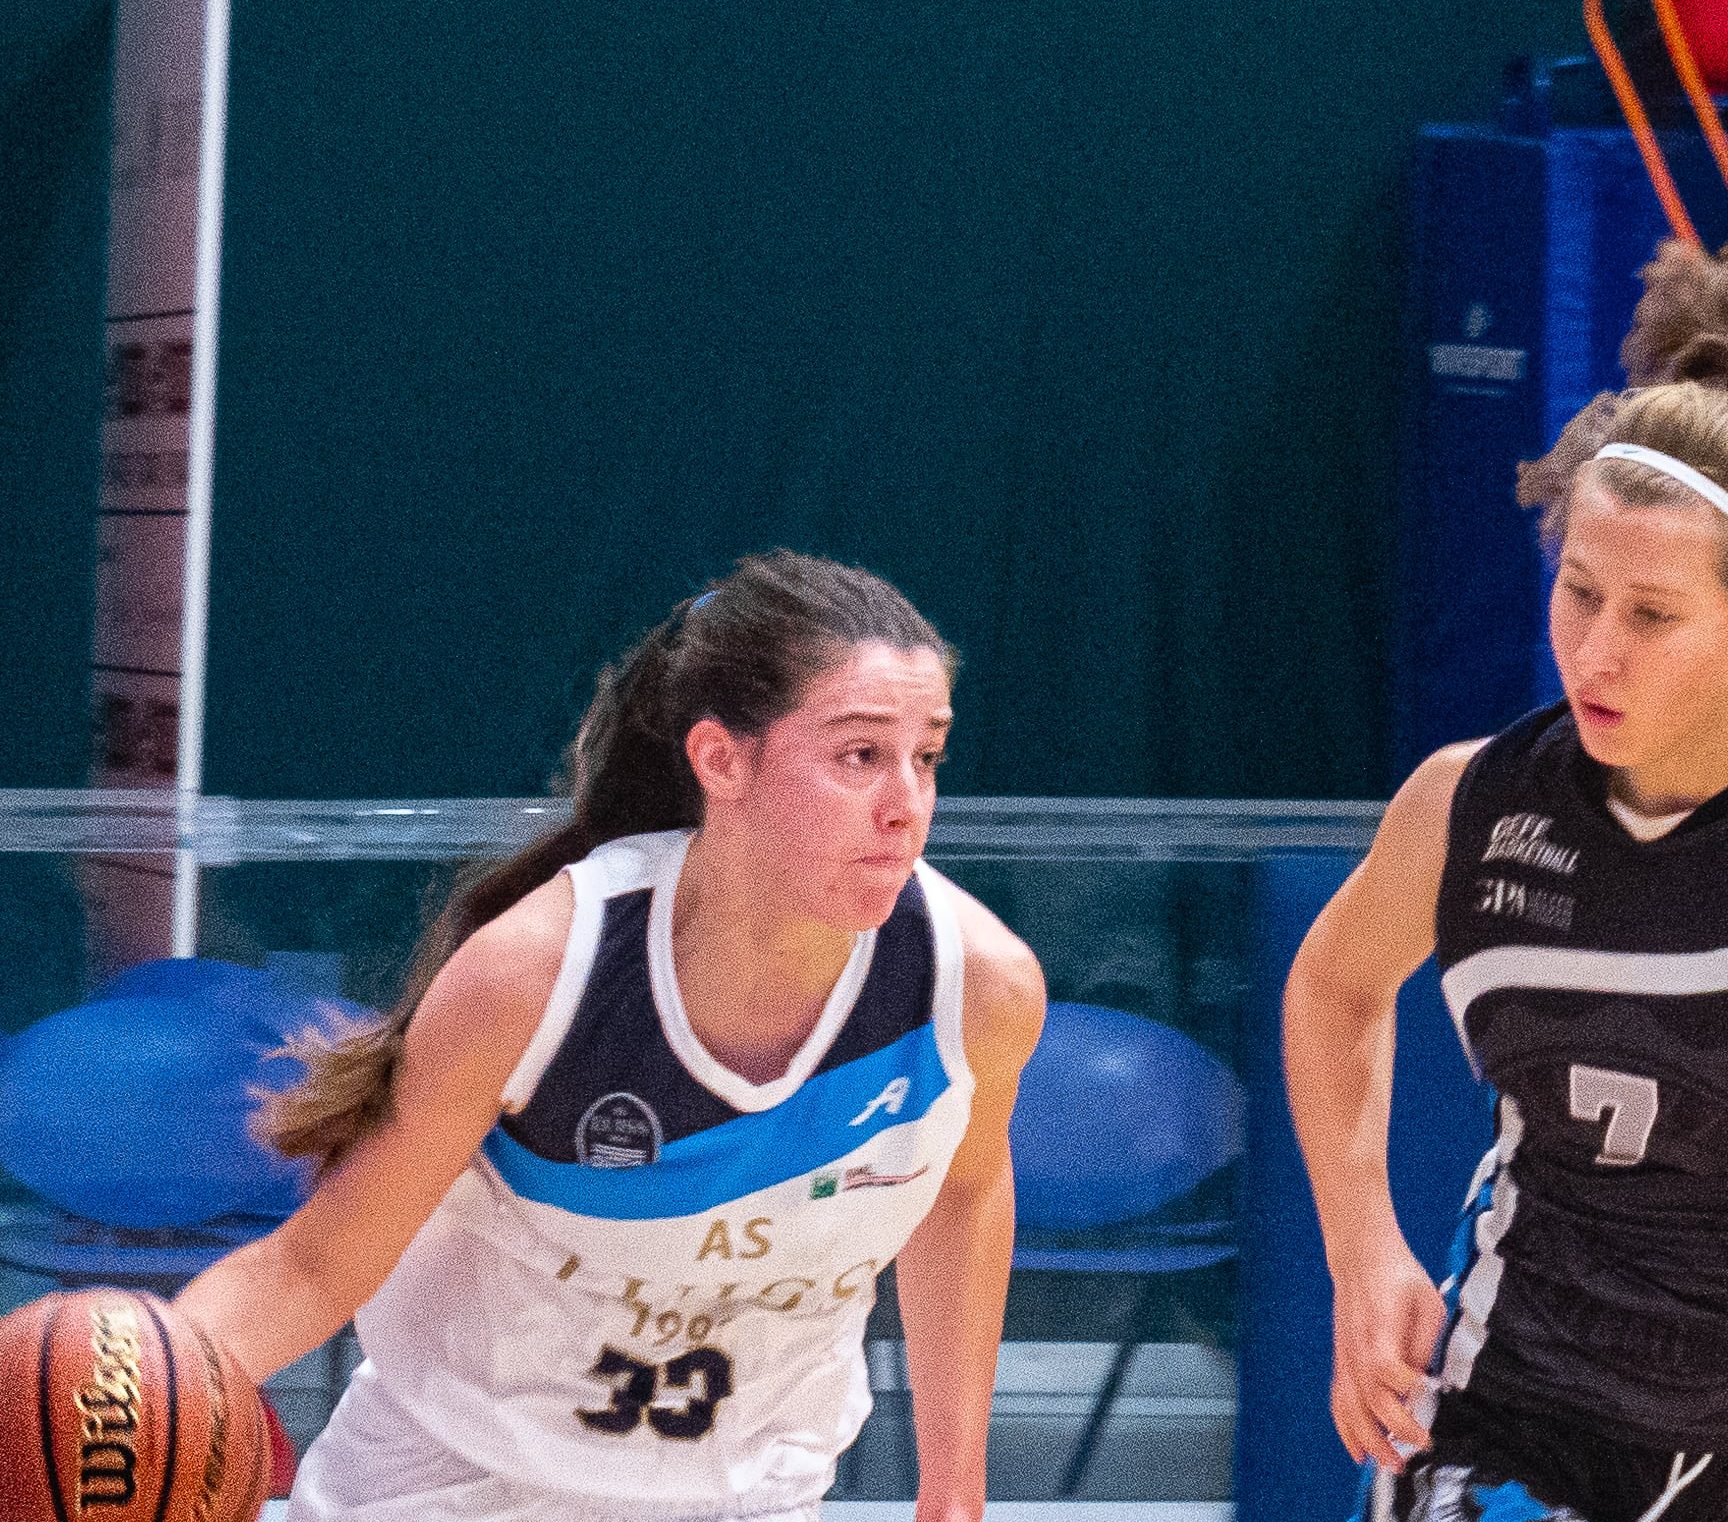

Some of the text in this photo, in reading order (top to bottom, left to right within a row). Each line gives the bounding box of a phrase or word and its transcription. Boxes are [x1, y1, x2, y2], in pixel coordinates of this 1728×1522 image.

[1570, 1063, 1659, 1166] 7
[695, 1216, 772, 1262] AS
[627, 1300, 733, 1347] 199
[574, 1343, 733, 1441] 33
